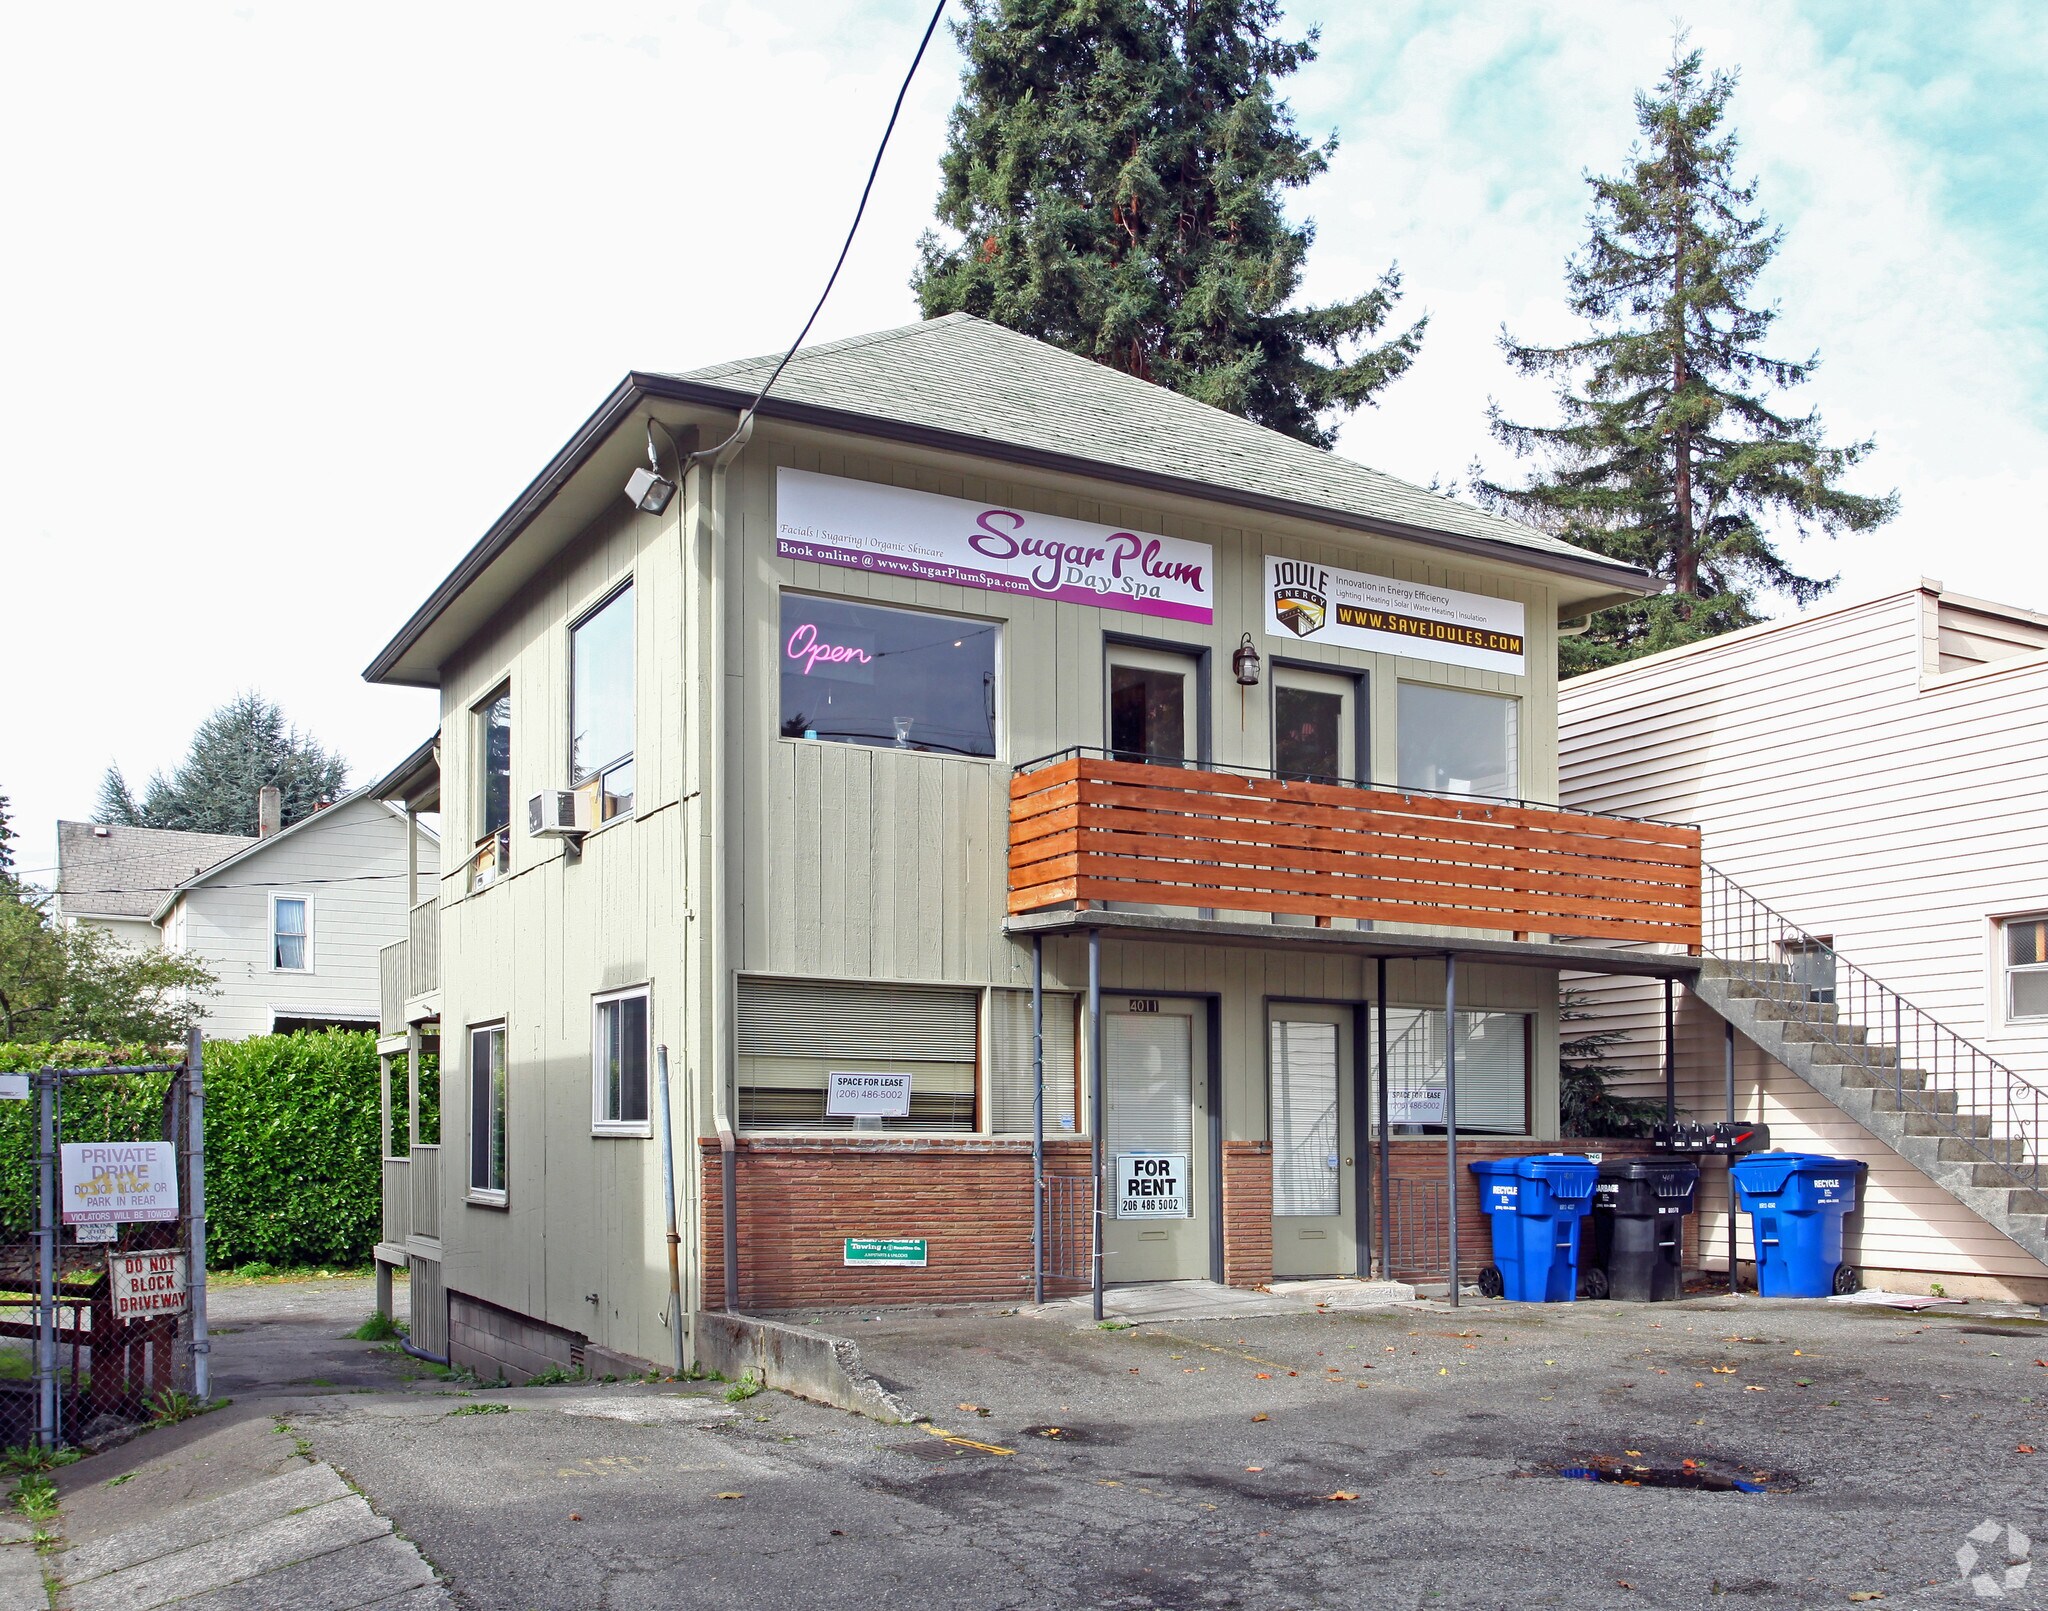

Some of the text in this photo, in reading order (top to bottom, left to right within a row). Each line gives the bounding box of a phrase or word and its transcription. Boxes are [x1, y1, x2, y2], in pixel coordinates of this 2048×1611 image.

[780, 524, 944, 558] Facials Sugaring Organic Skincare
[967, 510, 1204, 592] Sugar Plum
[780, 541, 1030, 591] Book online @ www.SugarPlumSpa.com
[1065, 566, 1161, 600] Day Spa
[1274, 561, 1329, 596] JOULE
[1277, 590, 1325, 606] ENERGY
[1336, 576, 1450, 606] Innovation in Energy Efficiency
[1336, 589, 1487, 623] Lighting Heating Solar Water Heating Insulation
[787, 623, 872, 675] Open
[1130, 1000, 1157, 1012] 4011
[837, 1077, 904, 1087] SPACE FOR LEASE
[836, 1089, 903, 1099] (206) 486-5002
[1392, 1091, 1441, 1099] SPACE FOR LEASE
[81, 1148, 157, 1163] PRIVATE
[92, 1164, 149, 1180] DRIVE
[1134, 1159, 1170, 1176] FOR
[74, 1184, 89, 1195] DO
[118, 1182, 149, 1194] BLOCK
[154, 1182, 167, 1192] OR
[1128, 1178, 1177, 1196] RENT
[1492, 1185, 1518, 1195] RECYCLE
[1813, 1179, 1840, 1189] RECYCLE
[87, 1195, 156, 1207] PARK IN REAR
[1123, 1198, 1178, 1211] 206 486 5002
[70, 1209, 172, 1222] VIOLATORS WILL BE TOWED
[850, 1243, 881, 1251] Towing
[126, 1254, 175, 1274] DO NOT
[131, 1274, 174, 1292] BLOCK
[120, 1292, 186, 1313] DRIVEWAY
